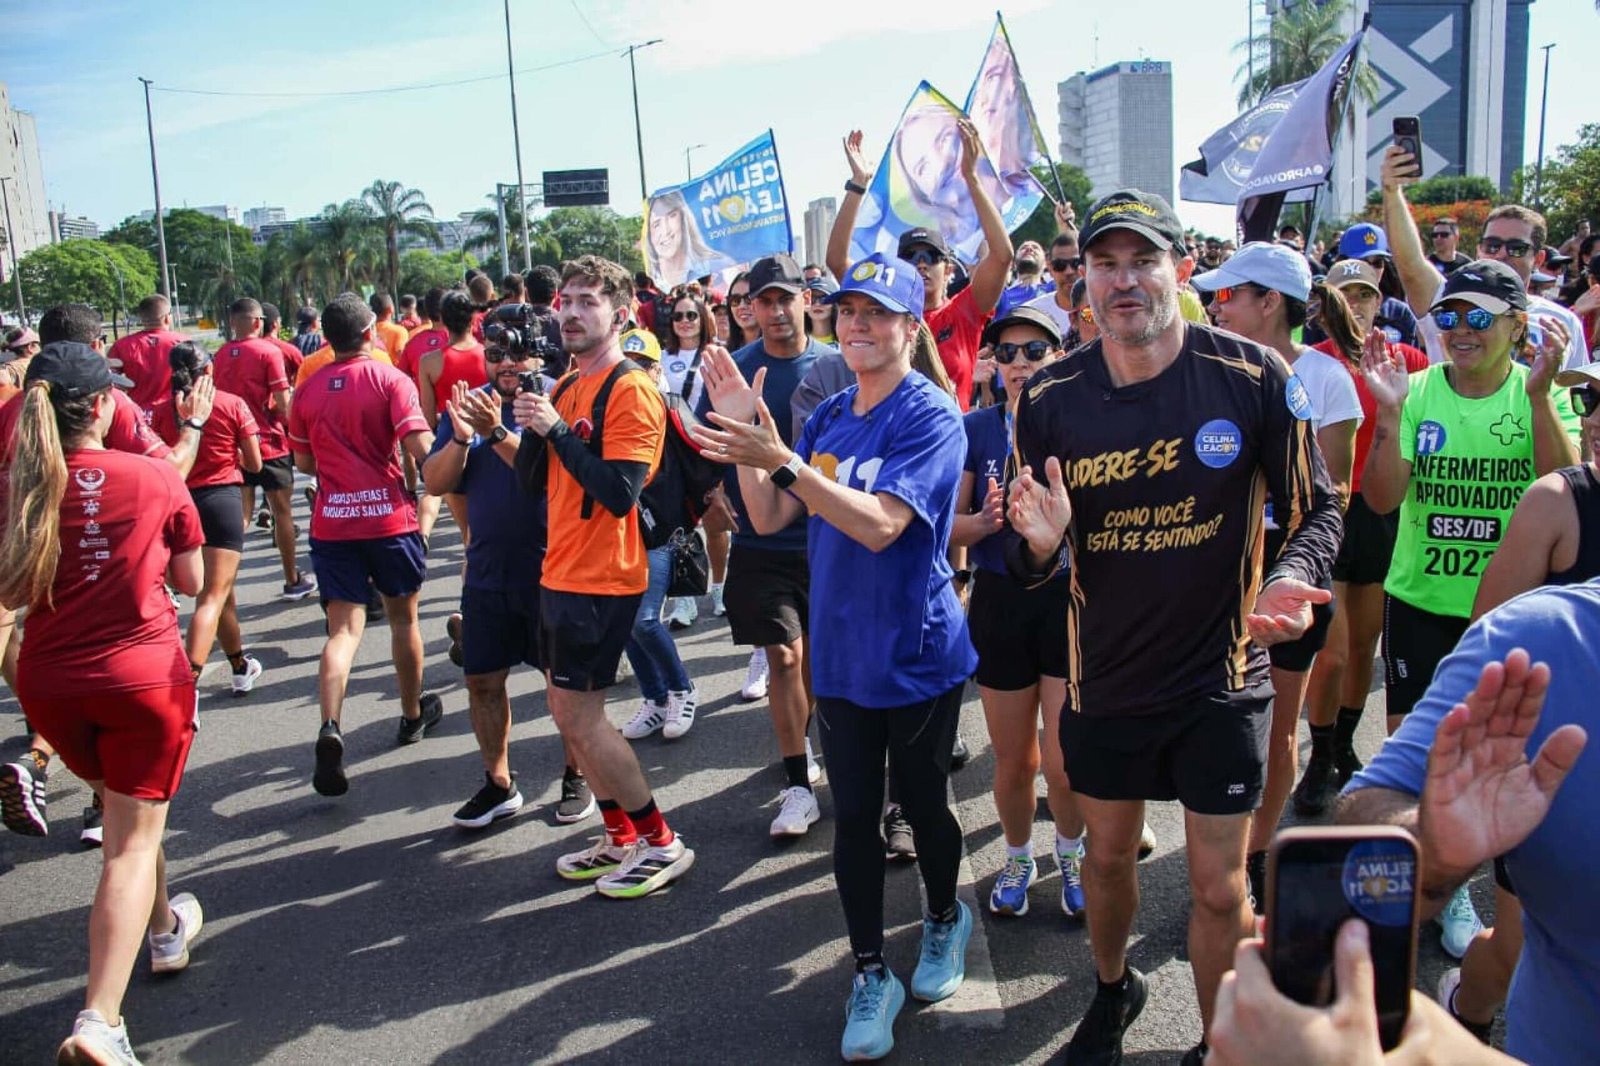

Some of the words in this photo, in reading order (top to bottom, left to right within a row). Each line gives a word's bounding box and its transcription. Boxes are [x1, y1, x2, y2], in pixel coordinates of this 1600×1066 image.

[1141, 61, 1162, 73] BRB
[873, 263, 896, 287] 11
[1202, 435, 1235, 444] CELINA
[1417, 430, 1438, 453] 11
[383, 488, 389, 500] E
[1416, 481, 1524, 511] APROVADOS
[1104, 506, 1150, 528] COMO
[1154, 495, 1196, 527] VOCÊ
[1087, 528, 1119, 552] ESTÁ
[1122, 531, 1141, 551] SE
[1143, 513, 1224, 551] SENTINDO?
[1432, 516, 1497, 539] SES/DF
